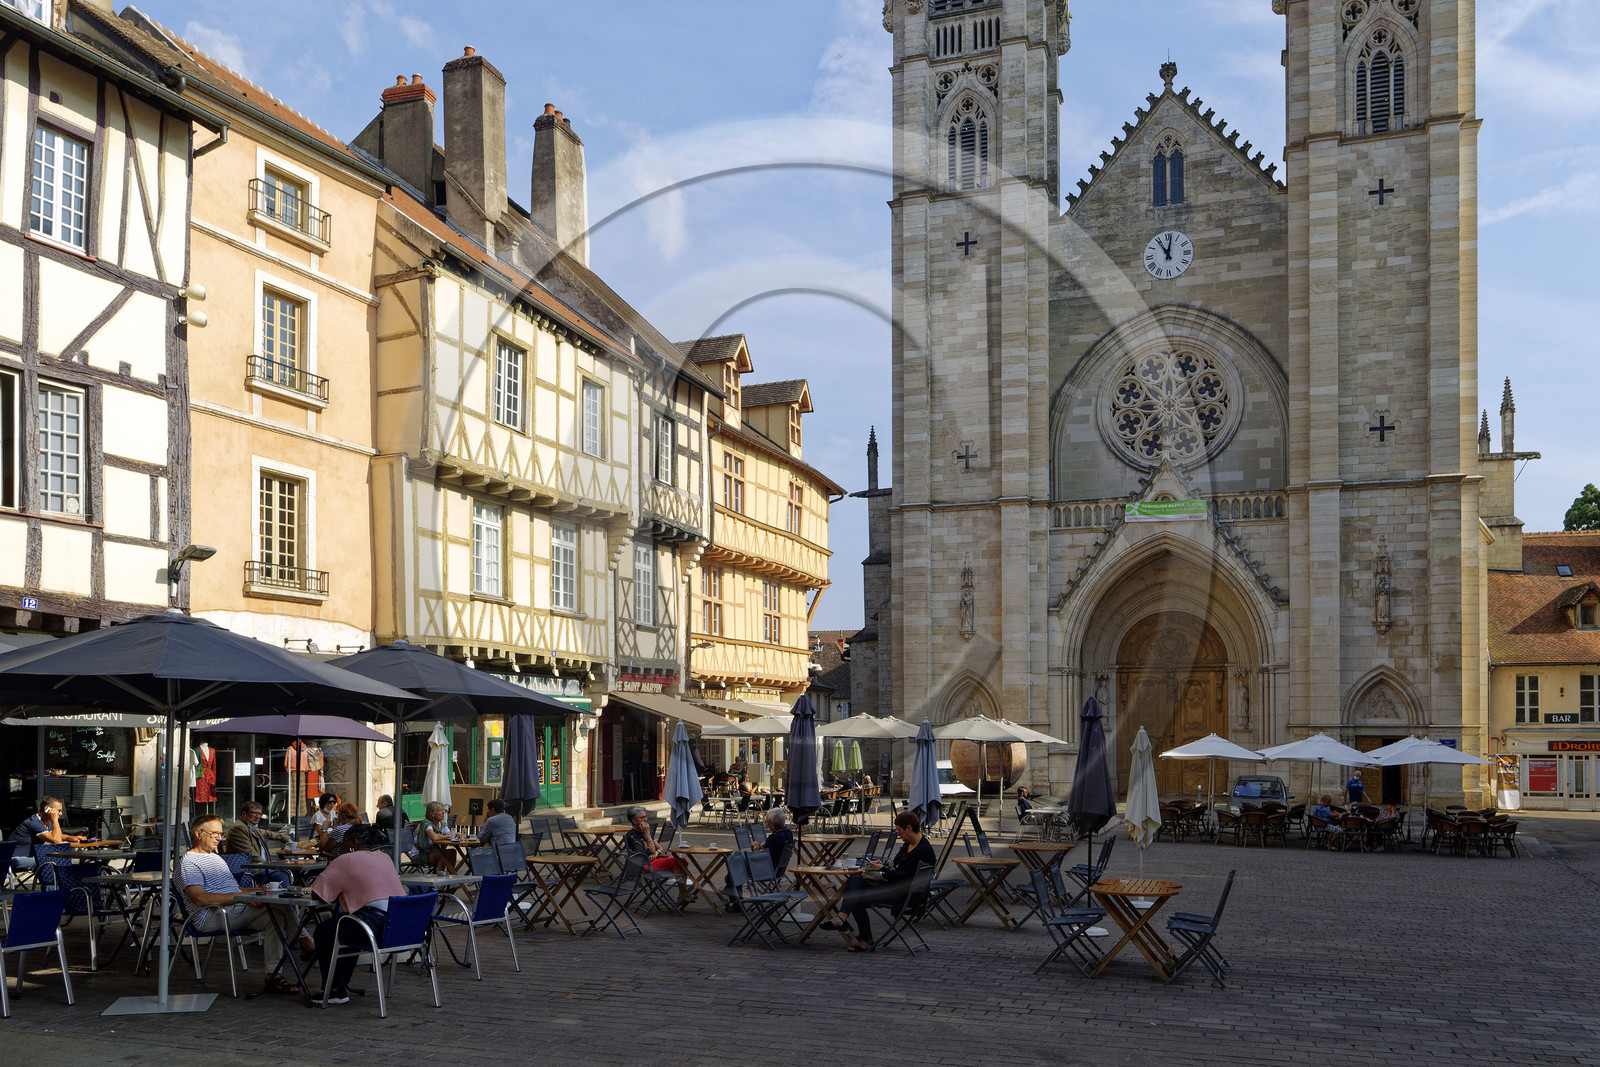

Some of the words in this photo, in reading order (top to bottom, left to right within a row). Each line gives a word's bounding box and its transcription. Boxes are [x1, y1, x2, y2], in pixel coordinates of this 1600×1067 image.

[25, 598, 36, 608] 12
[623, 681, 640, 692] SAINT
[640, 682, 663, 694] MARTIN
[50, 712, 123, 721] AURANT
